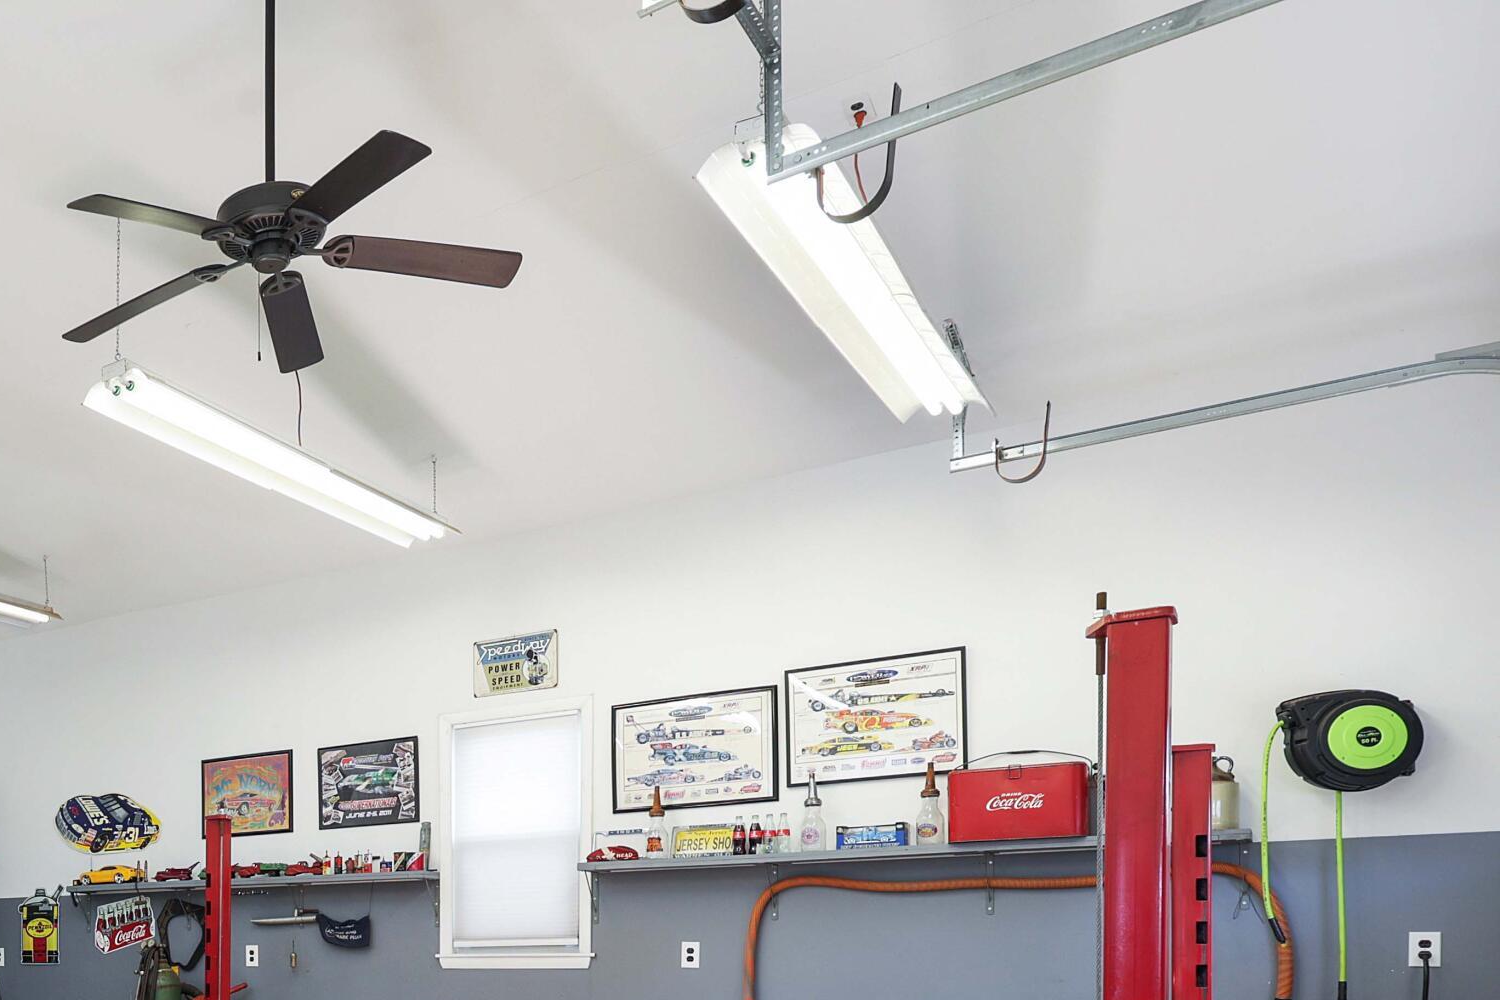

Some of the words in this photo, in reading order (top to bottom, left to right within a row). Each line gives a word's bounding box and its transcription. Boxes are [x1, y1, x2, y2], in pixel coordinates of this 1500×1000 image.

[477, 639, 550, 665] Speedway
[488, 662, 520, 674] POWER
[492, 674, 521, 686] SPEED
[986, 793, 1044, 811] Coca-Cola
[346, 811, 365, 819] JUNE
[126, 827, 139, 842] 31
[677, 838, 710, 852] JERSEY
[713, 837, 733, 850] SHO
[114, 924, 147, 945] Coca-Cola
